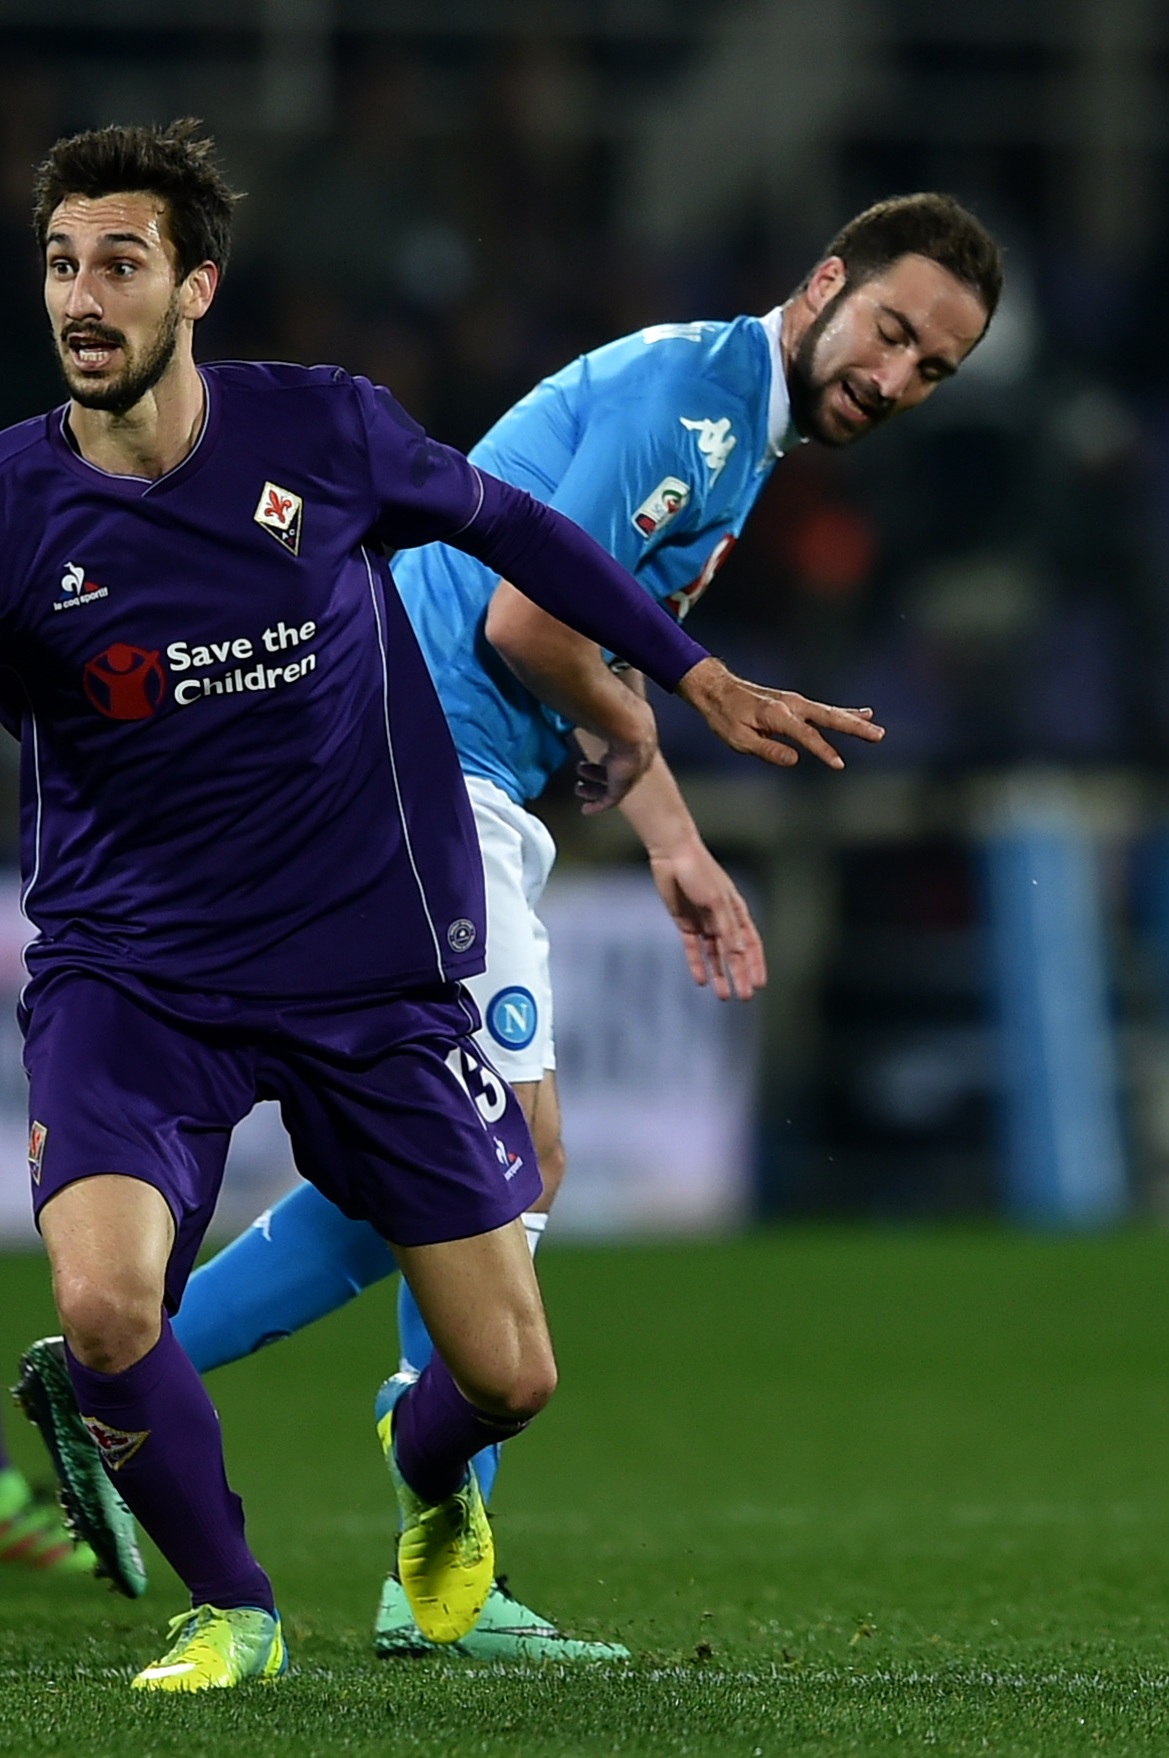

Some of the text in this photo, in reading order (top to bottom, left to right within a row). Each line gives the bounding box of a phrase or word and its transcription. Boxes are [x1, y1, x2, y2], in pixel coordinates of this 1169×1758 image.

[166, 621, 316, 672] Save the
[174, 653, 316, 705] Children
[504, 1003, 528, 1033] N
